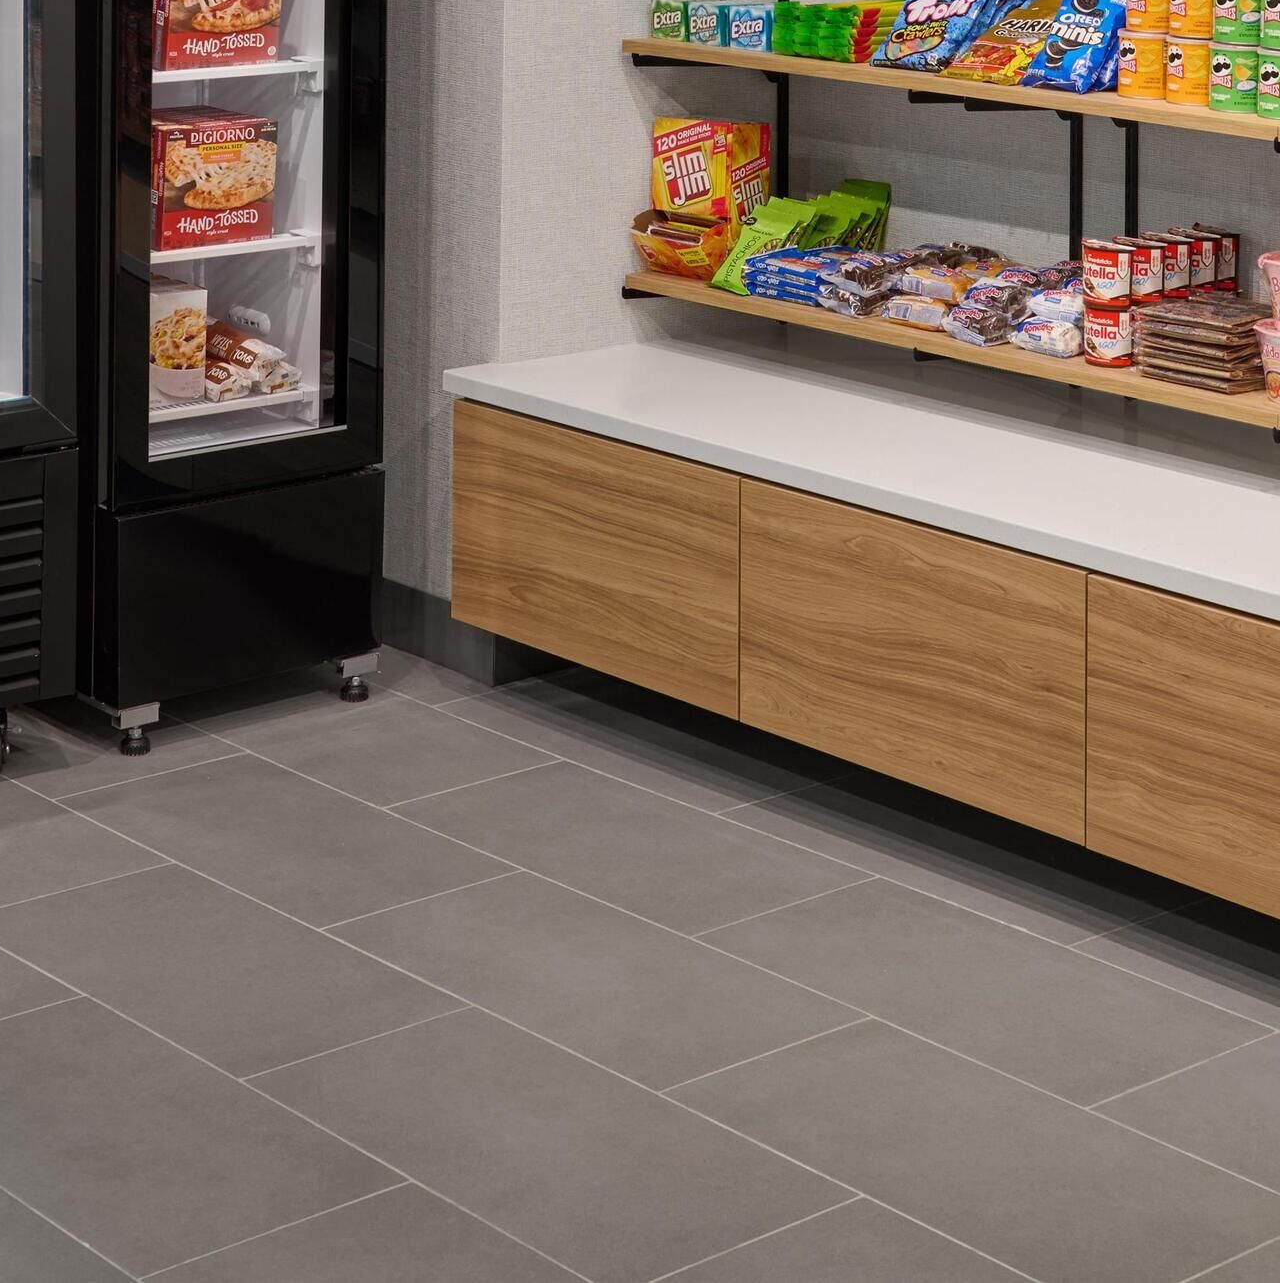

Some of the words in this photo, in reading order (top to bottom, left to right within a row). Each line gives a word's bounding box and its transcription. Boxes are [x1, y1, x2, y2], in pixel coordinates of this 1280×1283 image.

[653, 11, 683, 29] Extra
[690, 13, 718, 33] Extra
[730, 19, 764, 38] Extra
[1060, 14, 1101, 25] OREO
[891, 26, 945, 44] Crawlers
[1052, 22, 1105, 45] minis
[656, 135, 677, 152] 120
[677, 124, 712, 140] ORIGINAL
[663, 150, 706, 181] slim
[731, 169, 745, 181] 120
[746, 157, 766, 170] ORIGINAL
[674, 172, 710, 206] jim
[724, 235, 761, 283] PISTACHIOS
[1001, 270, 1037, 283] donettes
[970, 288, 1002, 301] donettes
[951, 308, 983, 319] donettes
[1023, 324, 1055, 334] donettes
